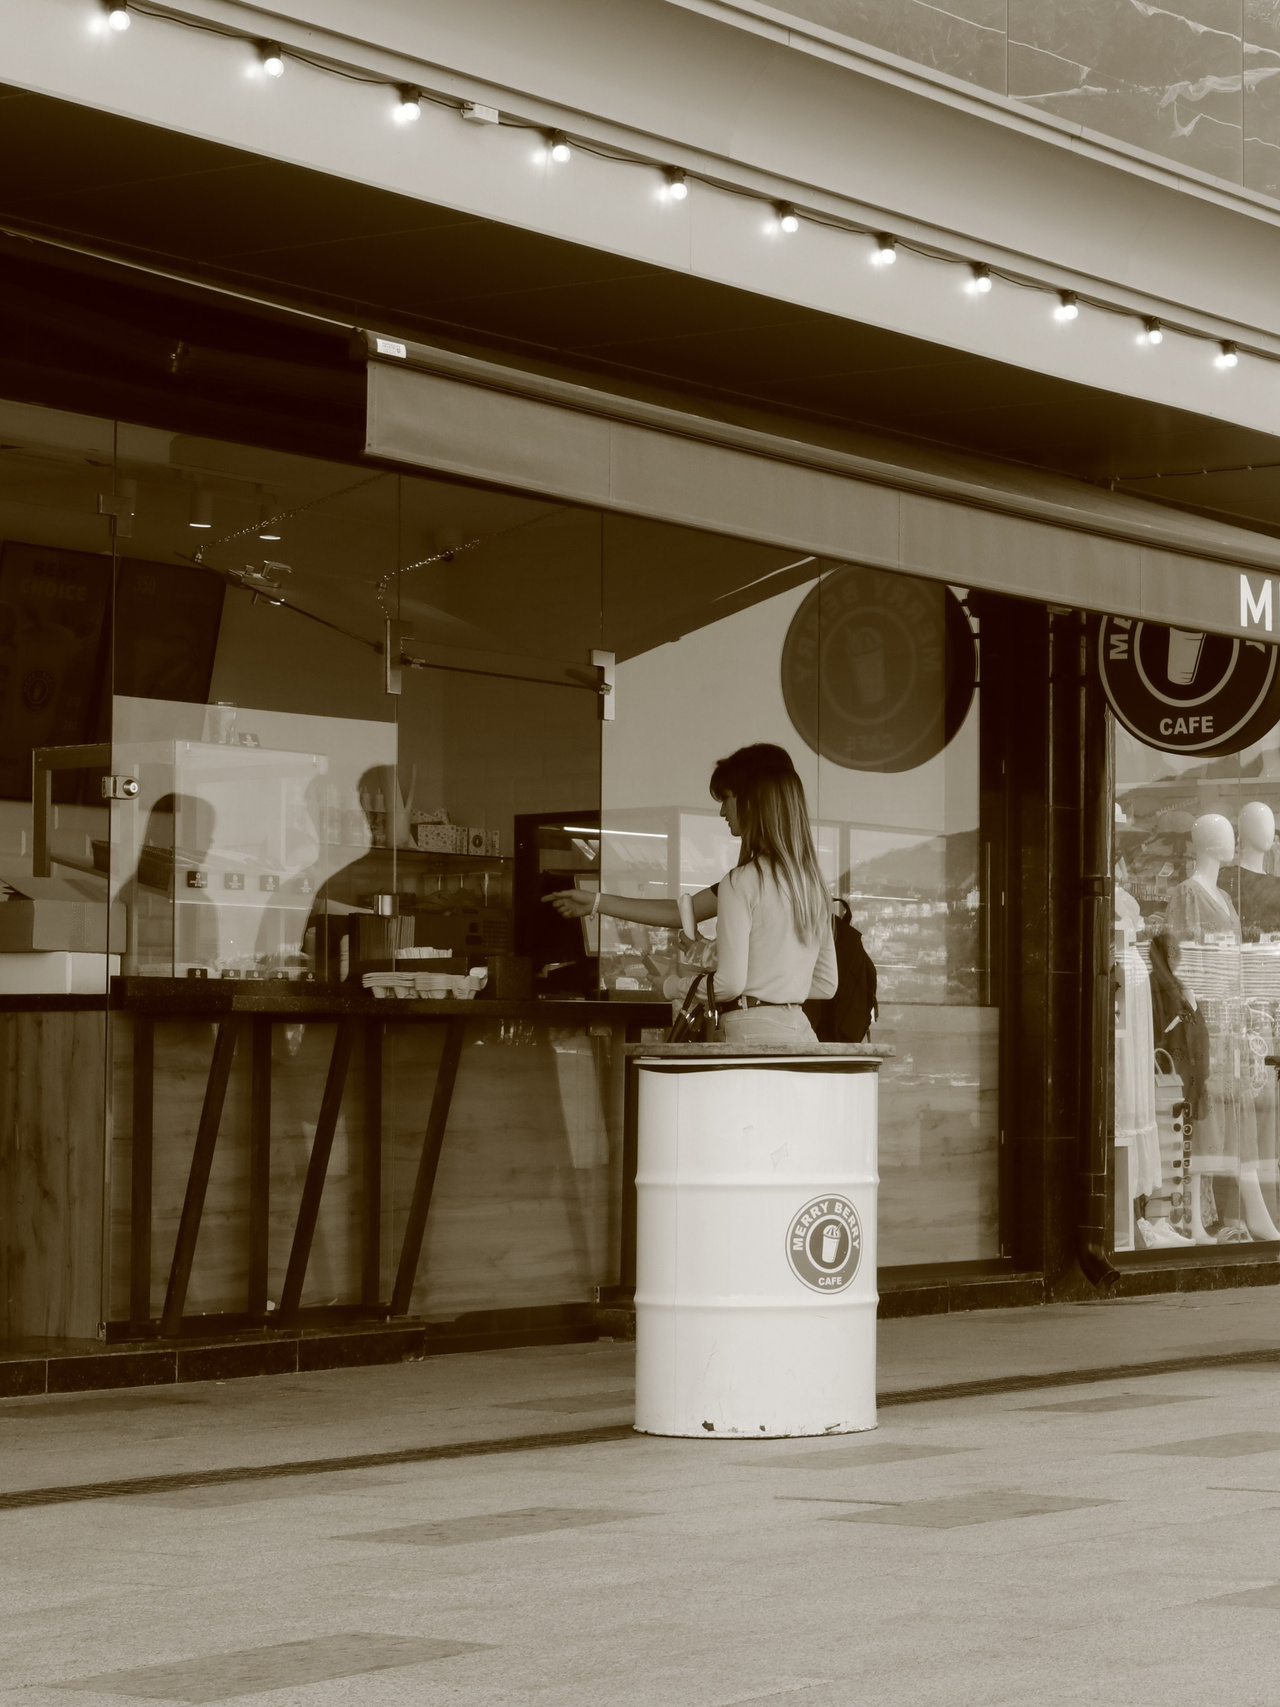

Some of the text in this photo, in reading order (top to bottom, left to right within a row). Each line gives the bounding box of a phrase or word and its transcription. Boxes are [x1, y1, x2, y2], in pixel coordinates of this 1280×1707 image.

[19, 578, 88, 602] CHOICE
[1159, 715, 1214, 736] CAFE
[792, 1201, 859, 1250] MERRY BERRY
[818, 1276, 842, 1286] CAFE
